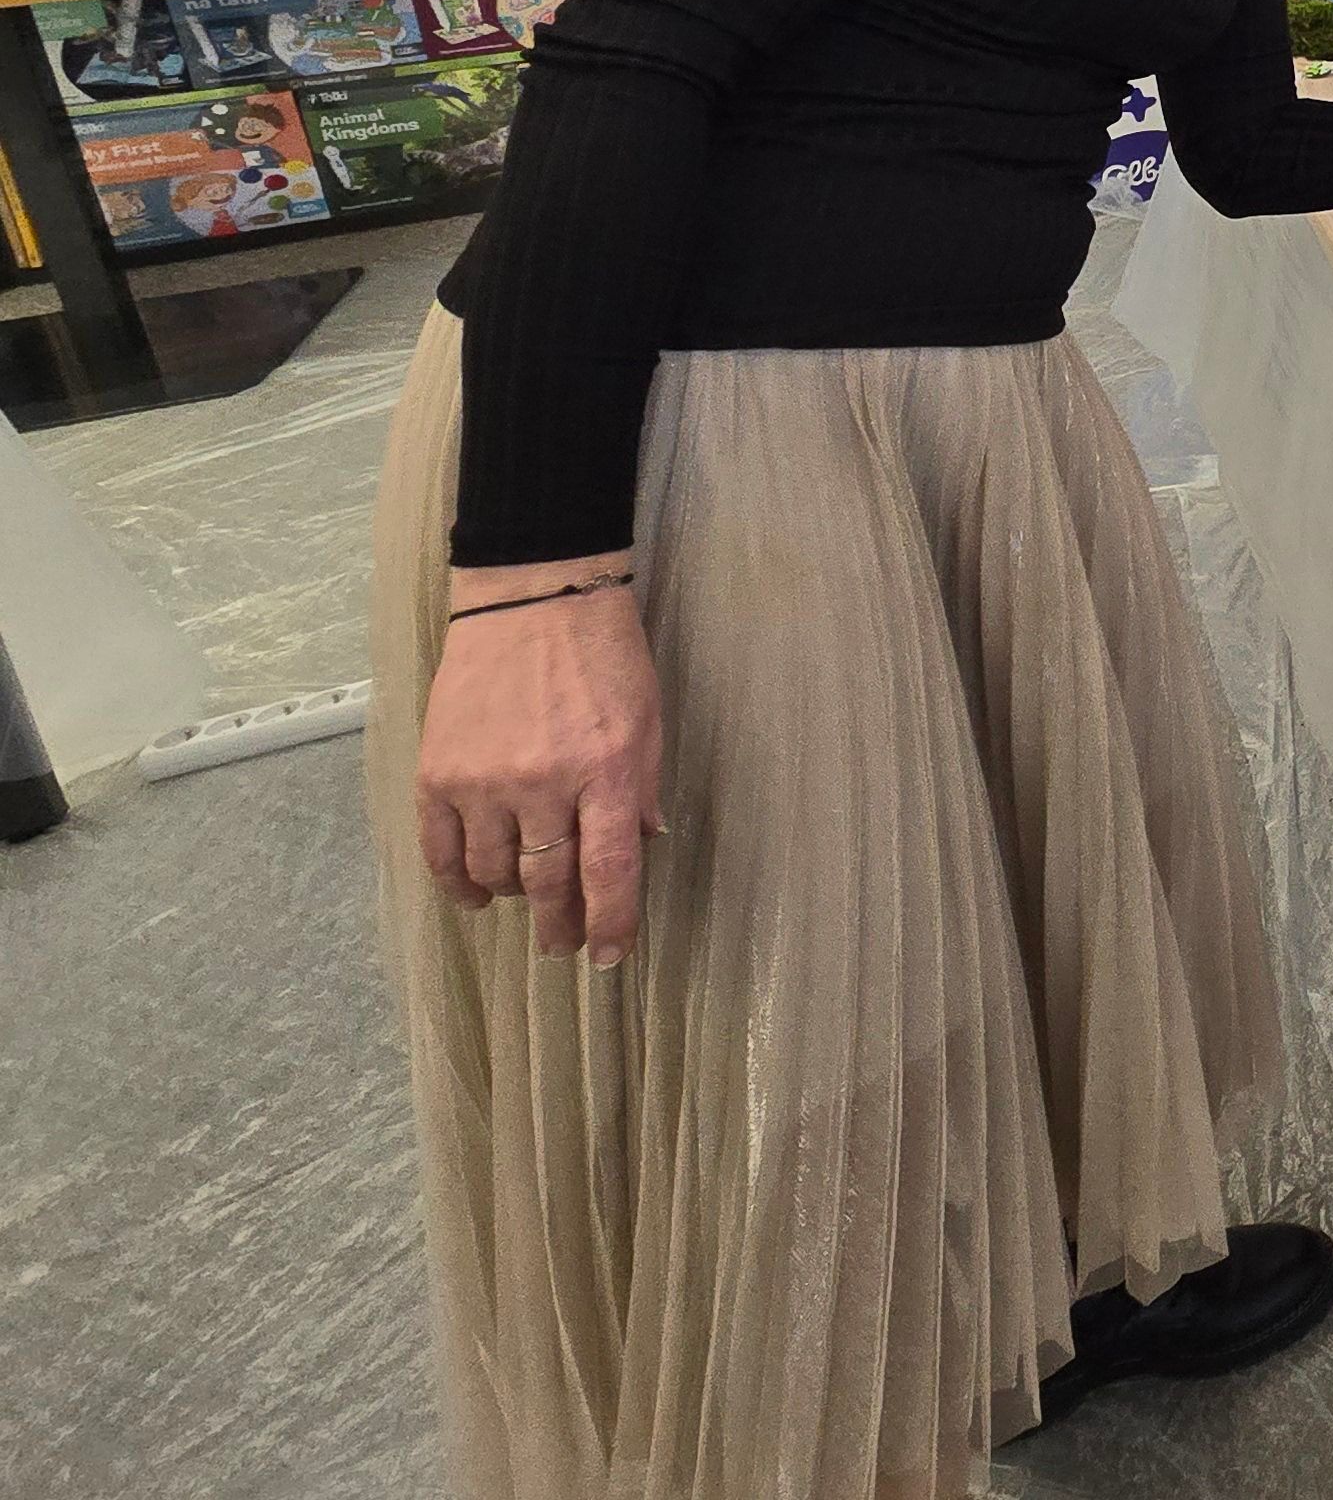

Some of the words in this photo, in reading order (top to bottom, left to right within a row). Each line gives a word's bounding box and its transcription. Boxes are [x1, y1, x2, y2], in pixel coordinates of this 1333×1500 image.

[184, 0, 212, 11] na
[320, 109, 385, 128] Animal
[322, 119, 421, 142] Kingdoms
